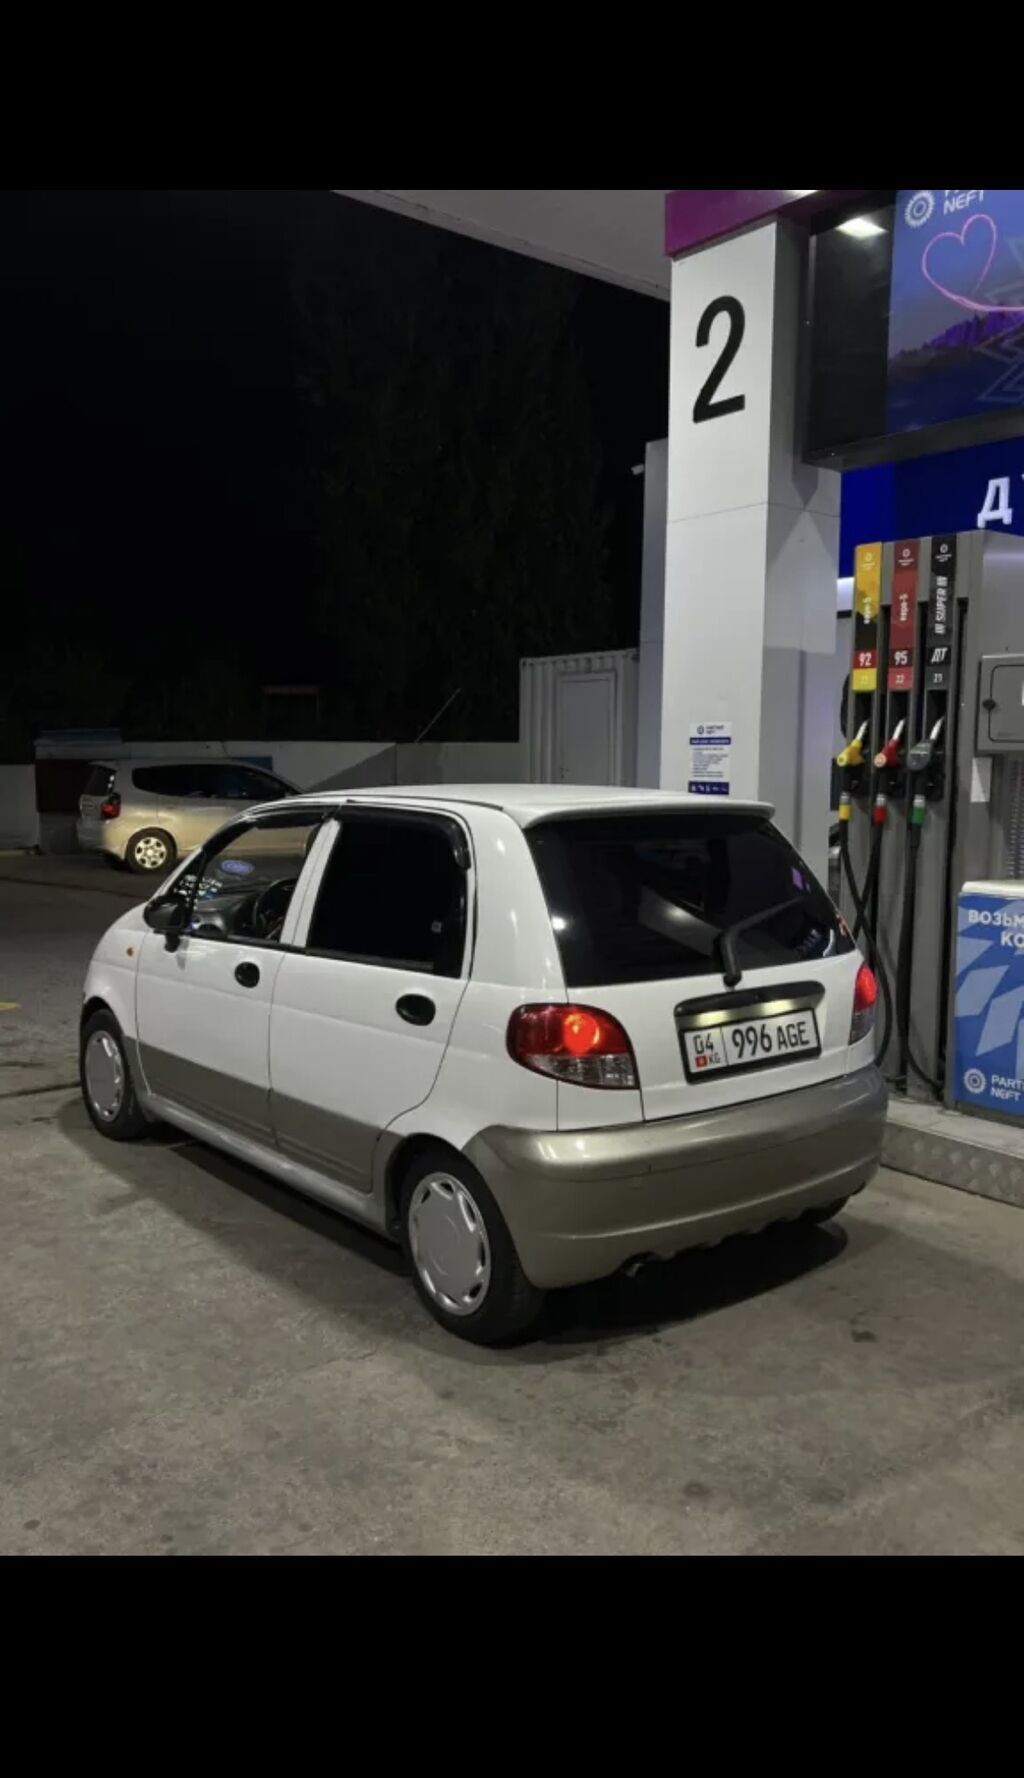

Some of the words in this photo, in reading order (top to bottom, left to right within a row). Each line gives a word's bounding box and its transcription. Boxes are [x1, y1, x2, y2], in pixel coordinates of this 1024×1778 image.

[693, 294, 746, 424] 2
[977, 474, 1024, 529] Д
[935, 587, 947, 622] SUPER
[859, 652, 872, 666] 92
[894, 650, 908, 665] 95
[1001, 930, 1024, 949] КО
[693, 1032, 715, 1055] 04
[732, 1023, 772, 1058] 996
[776, 1021, 811, 1051] AGE
[708, 1052, 721, 1065] KG
[991, 1074, 1024, 1091] PART
